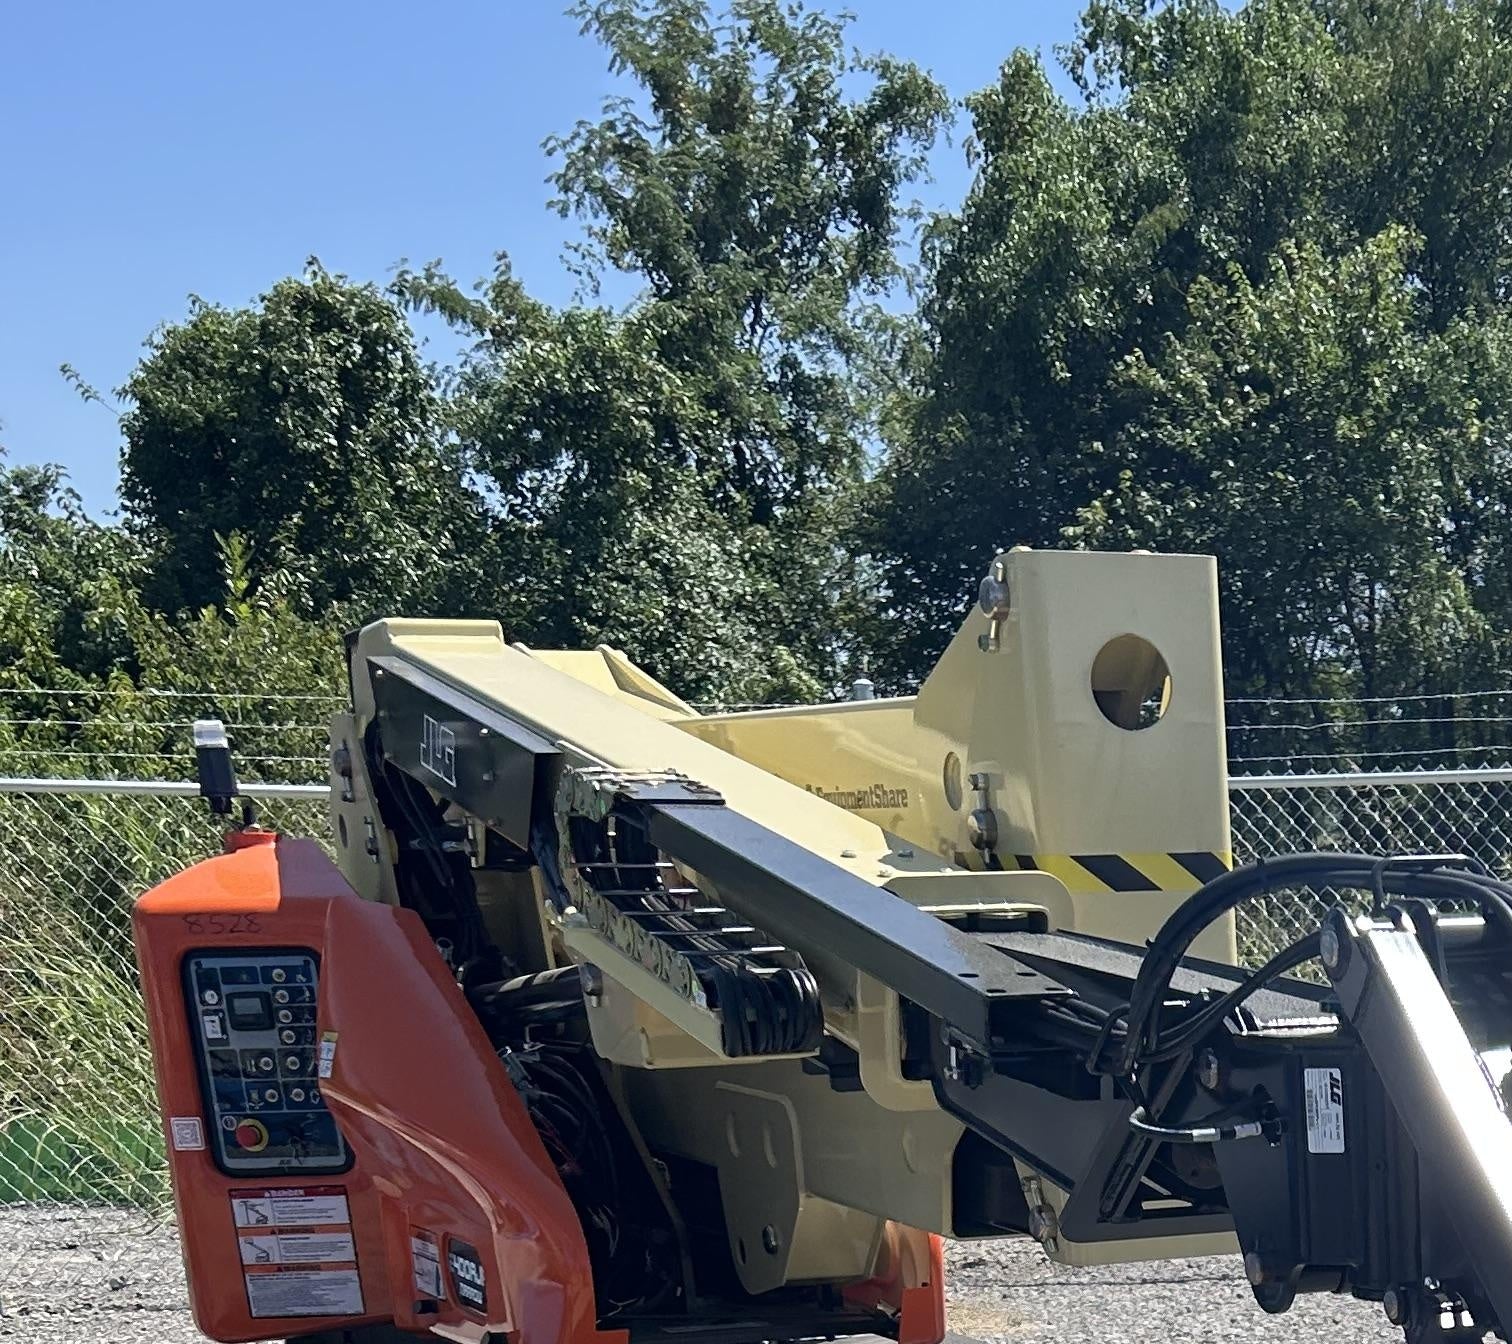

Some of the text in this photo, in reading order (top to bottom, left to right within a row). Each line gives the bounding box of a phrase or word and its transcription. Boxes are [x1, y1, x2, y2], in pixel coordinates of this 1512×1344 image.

[420, 714, 456, 787] JLG
[182, 912, 262, 934] 8528
[1329, 1072, 1341, 1106] JLG
